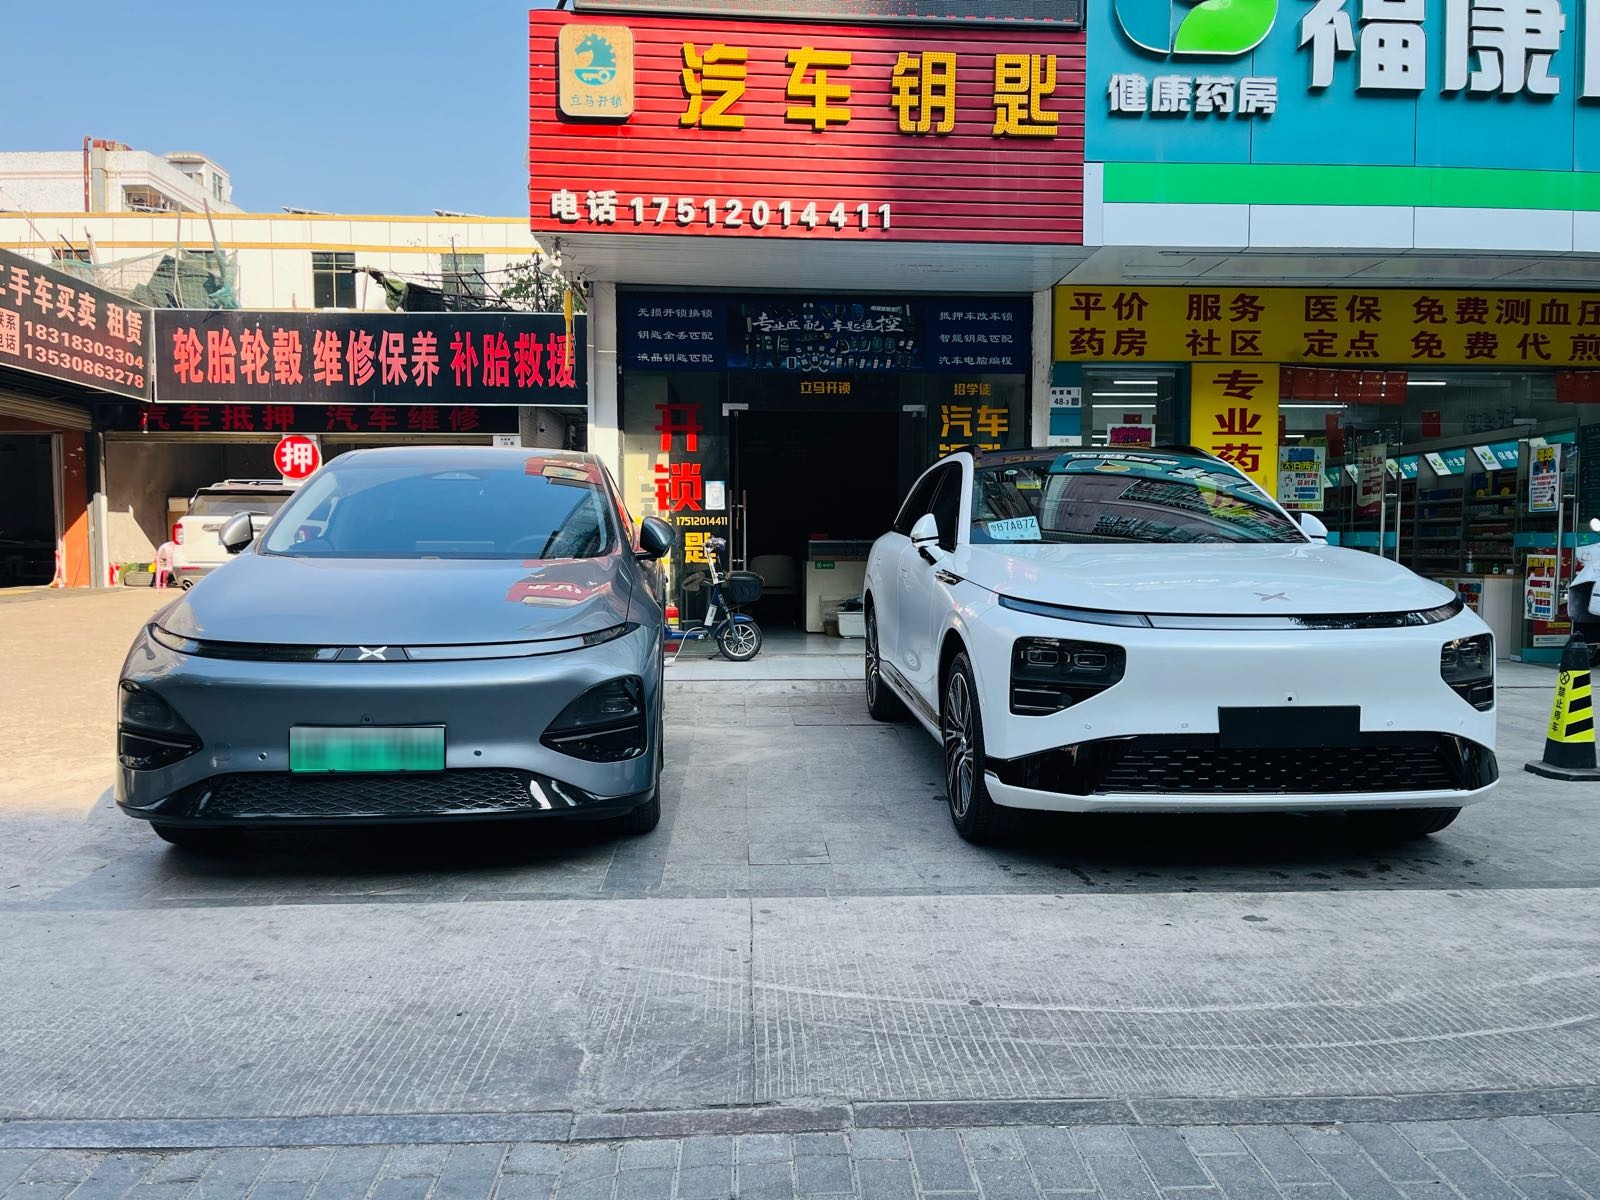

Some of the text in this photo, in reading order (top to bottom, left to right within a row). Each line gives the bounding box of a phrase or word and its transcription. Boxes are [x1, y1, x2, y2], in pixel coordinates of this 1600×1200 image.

[570, 95, 623, 108] 立马开锁
[680, 42, 1059, 136] 汽车钥匙
[1108, 73, 1278, 114] 健康药房
[551, 189, 892, 229] 电话 17512014411
[0, 264, 143, 346] 手车买卖 租赁
[637, 307, 713, 318] 无损开锁换锁
[939, 311, 1013, 322] 抵押车改车锁
[1069, 292, 1149, 321] 平价
[1186, 293, 1265, 322] 服务
[1304, 295, 1382, 323] 医保
[24, 320, 145, 369] 18318303304
[637, 330, 714, 340] 钥匙全丢匹配
[939, 334, 1013, 343] 智能钥匙匹配
[1069, 327, 1600, 361] 药房 社区 定点 免费代煎
[24, 343, 145, 389] 13530863278
[173, 327, 577, 388] 轮胎轮毂 维修保养 补胎救援
[637, 353, 714, 362] 液晶钥匙匹配
[939, 356, 1013, 366] 汽车电脑编程
[800, 381, 851, 394] 立马开锁
[953, 383, 991, 396] 招学徒
[139, 405, 481, 431] 汽车抵押 汽车维修
[941, 405, 1008, 437] 汽车
[281, 442, 313, 473] 押
